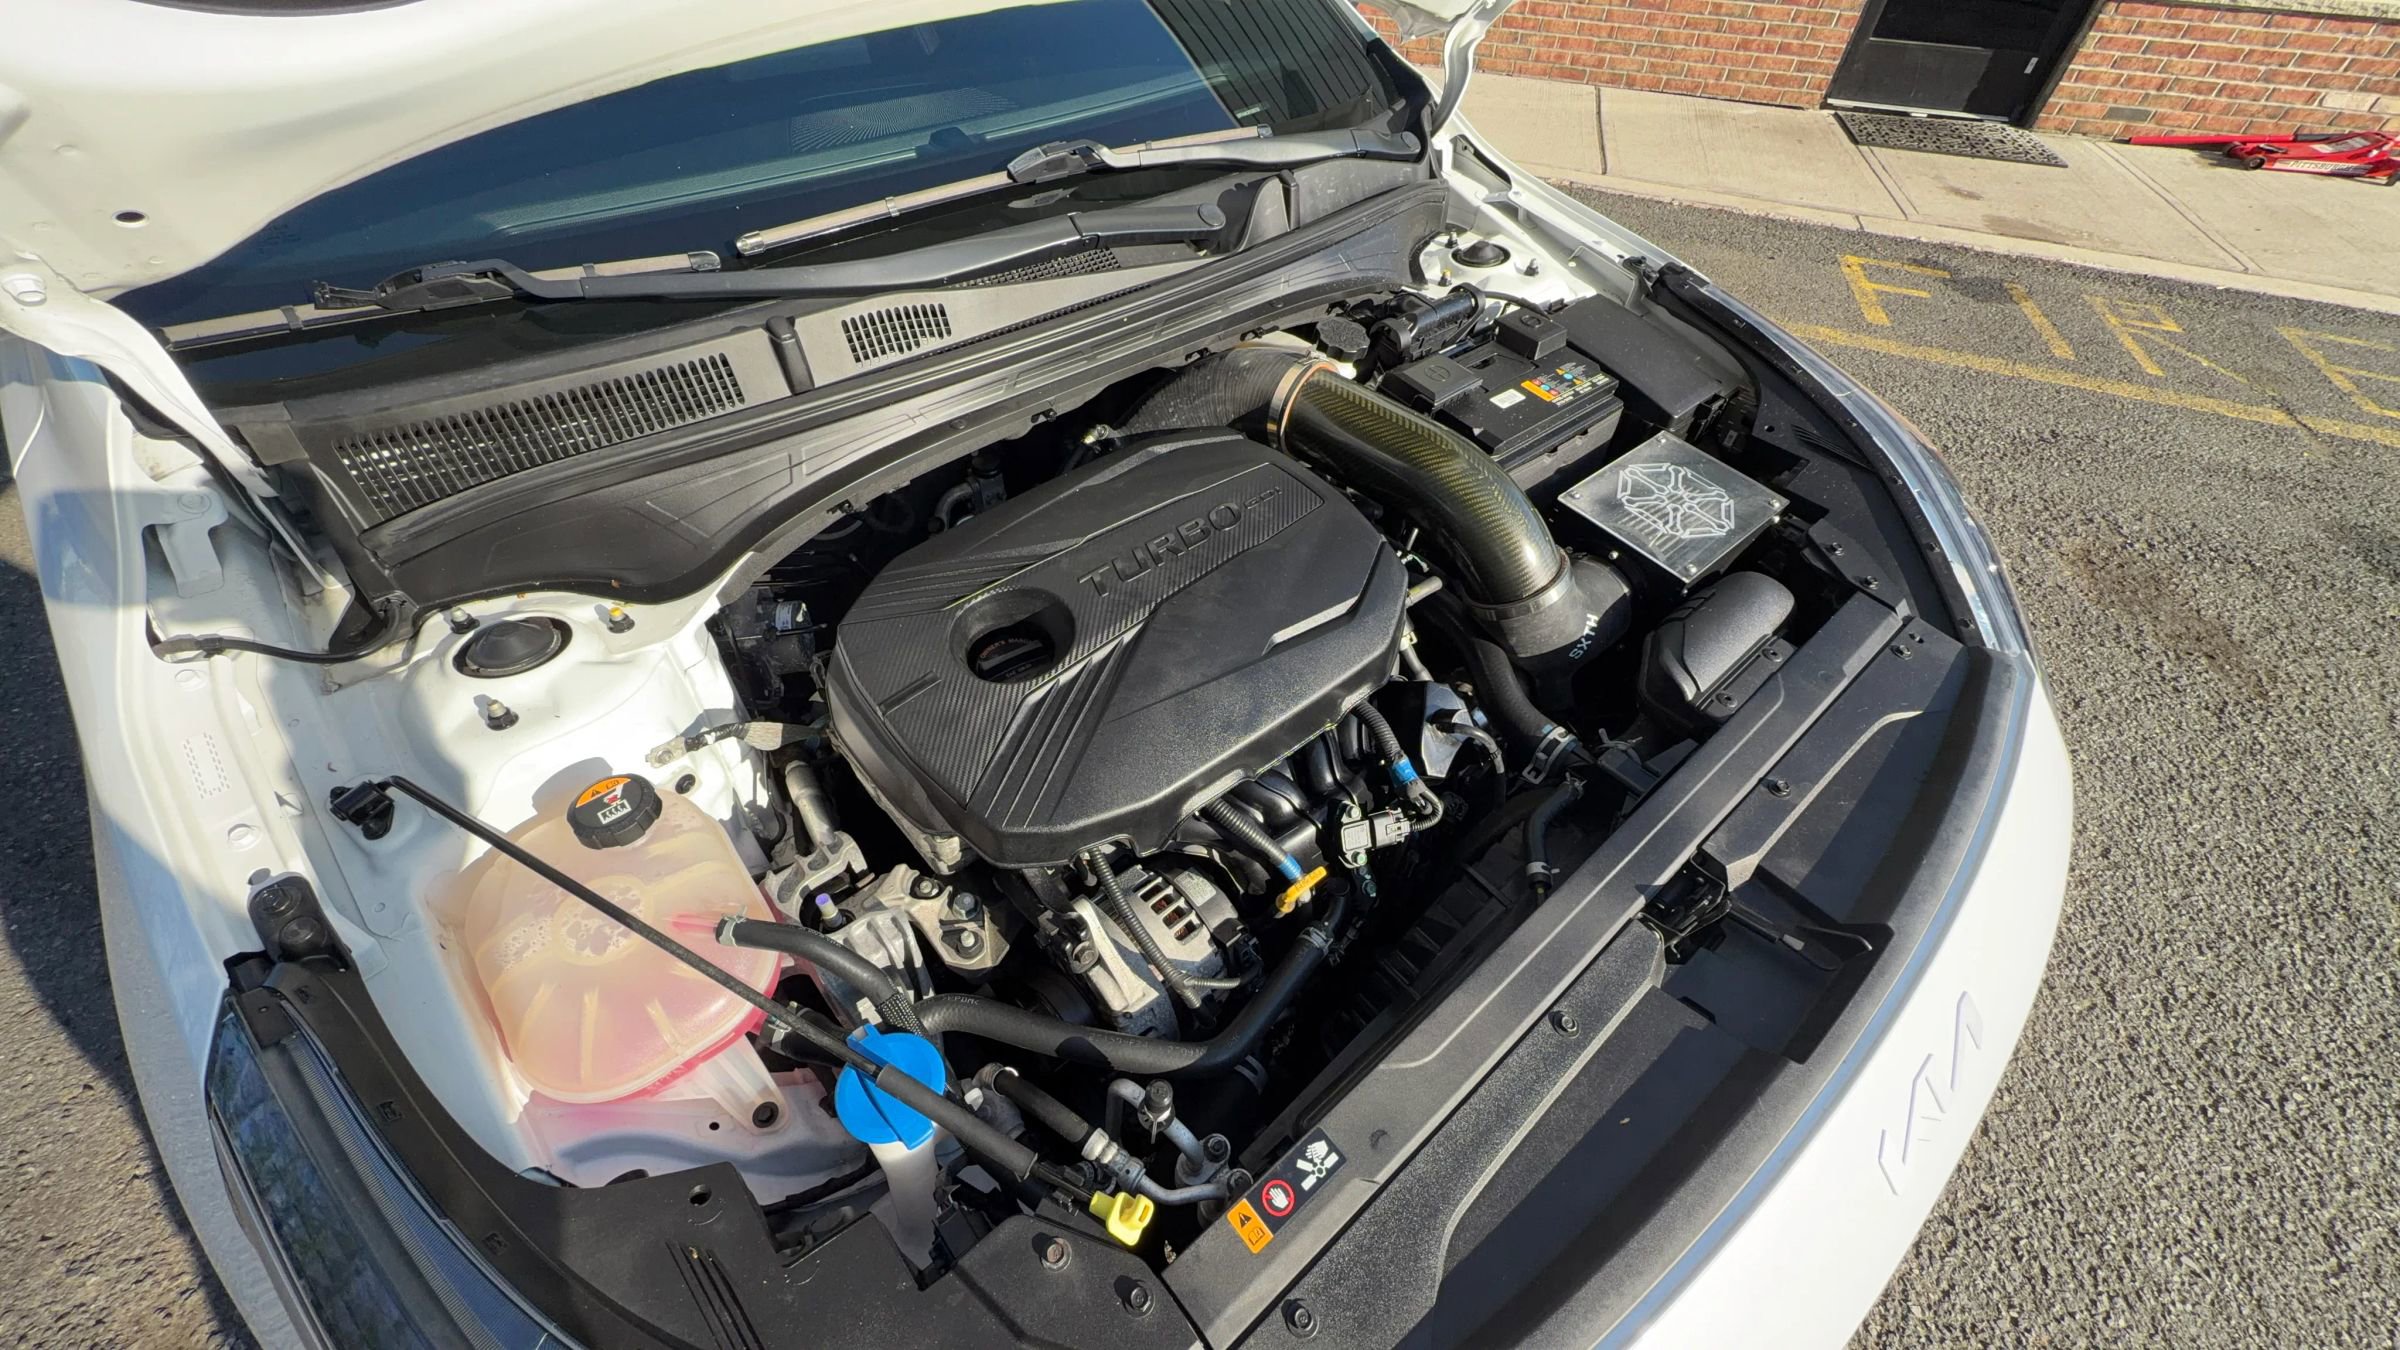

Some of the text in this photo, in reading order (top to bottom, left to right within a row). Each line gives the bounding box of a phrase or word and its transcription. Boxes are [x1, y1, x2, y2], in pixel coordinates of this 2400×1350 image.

[1838, 253, 2400, 418] FIRE
[1077, 485, 1283, 598] TURBO GDI
[1568, 613, 1599, 660] SXTH
